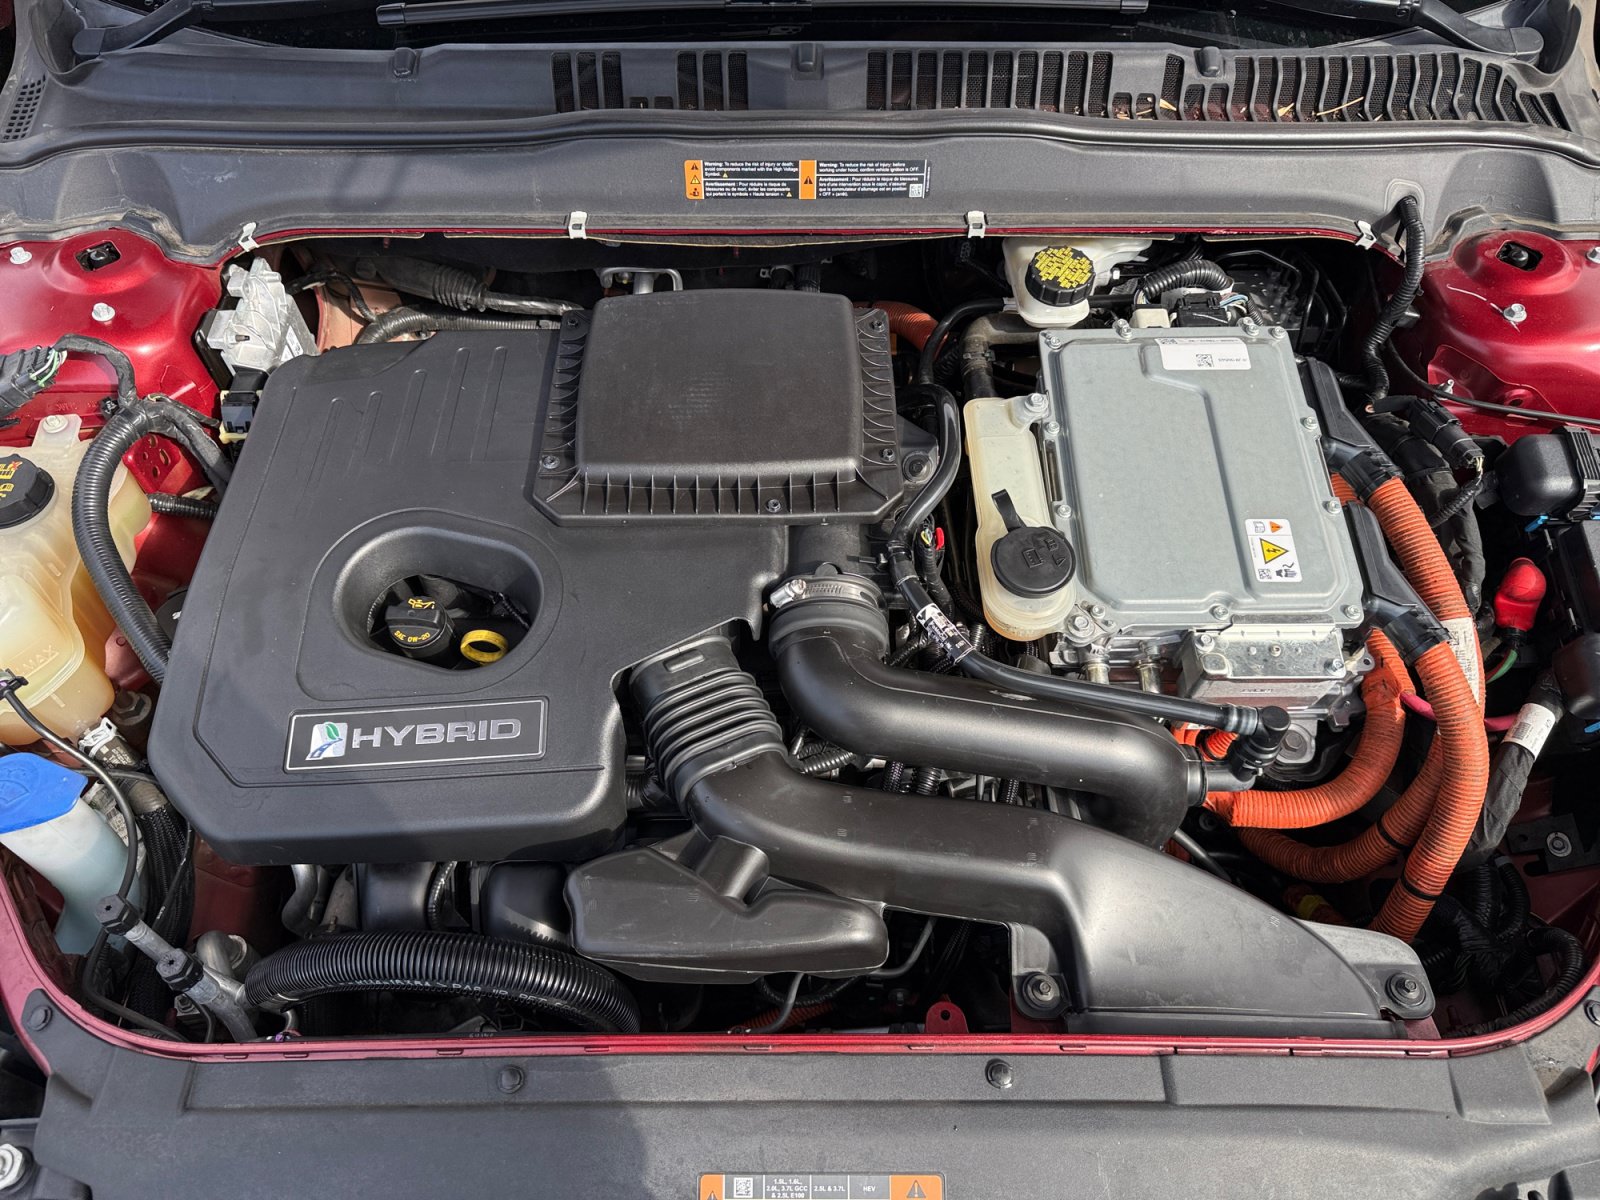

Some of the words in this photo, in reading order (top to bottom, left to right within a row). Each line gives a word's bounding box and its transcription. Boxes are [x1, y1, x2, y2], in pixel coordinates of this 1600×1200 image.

[394, 630, 407, 641] SAE
[407, 632, 431, 643] 0W-20
[351, 718, 522, 749] HYBRID
[862, 1185, 876, 1193] HEV
